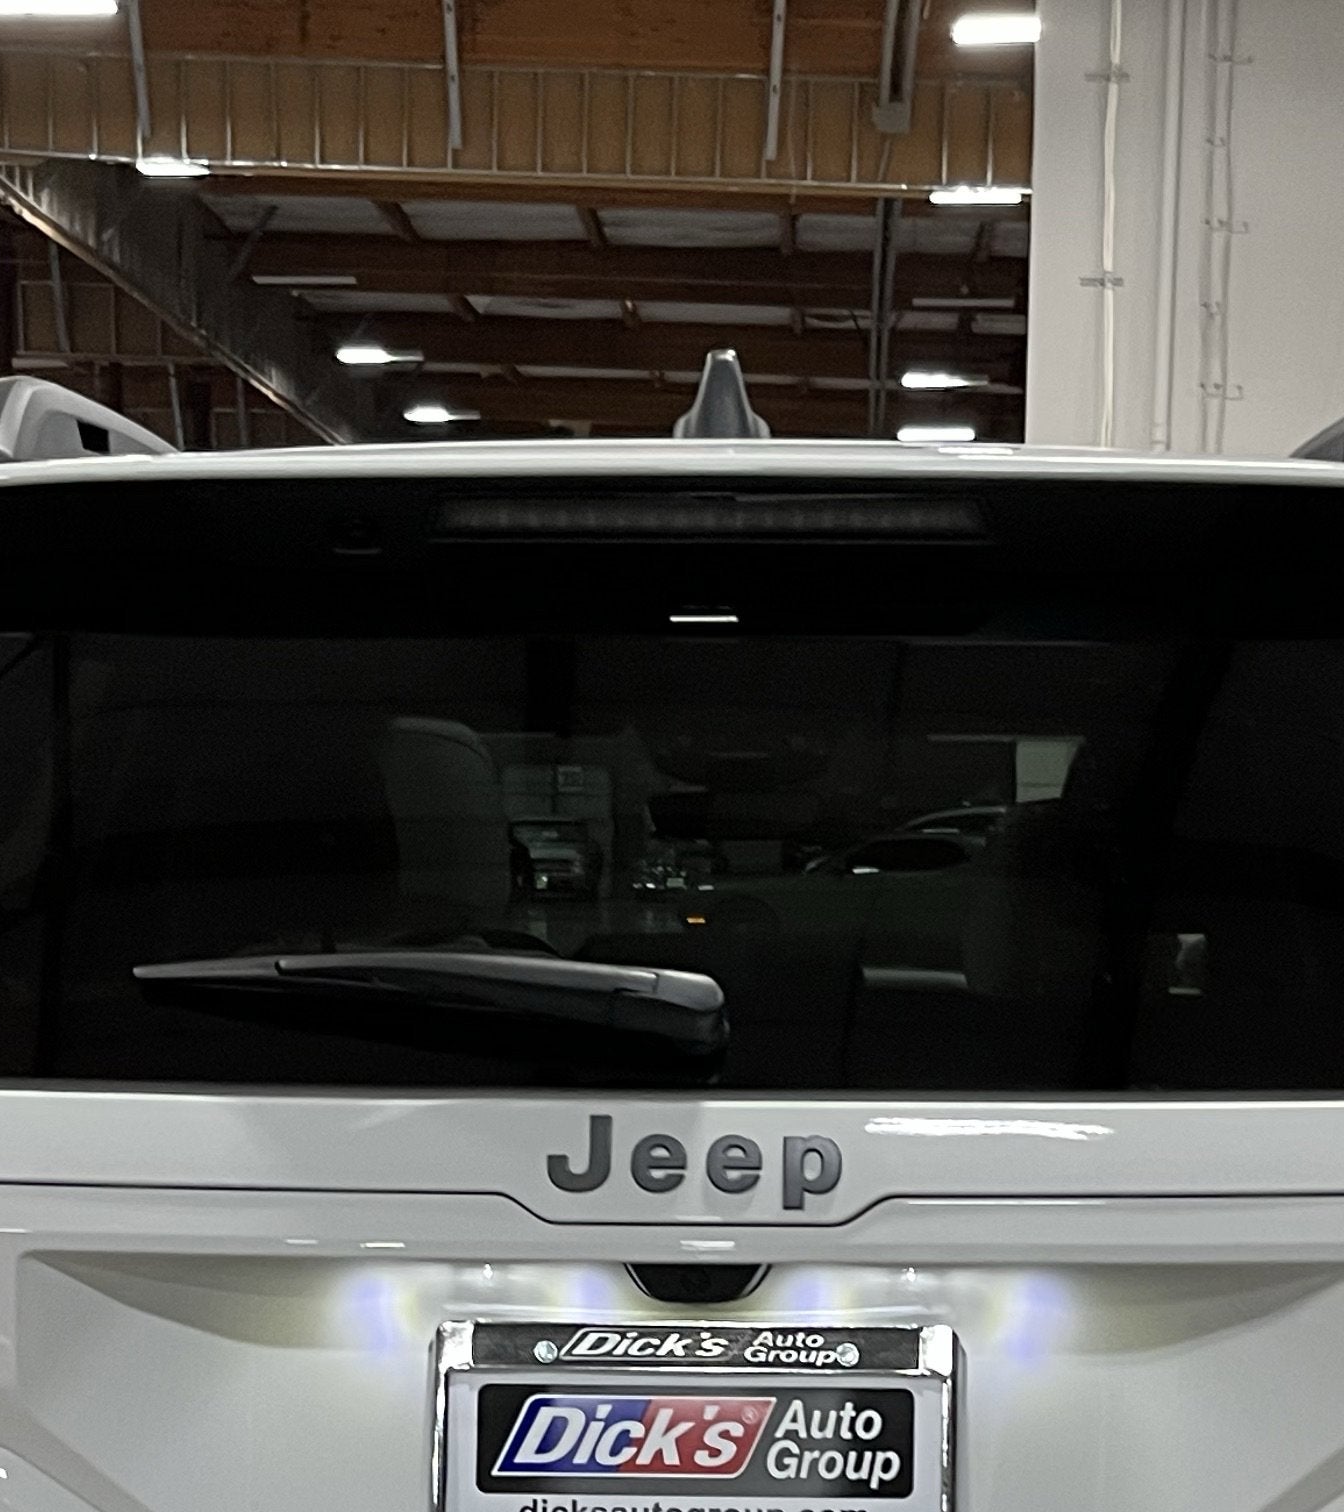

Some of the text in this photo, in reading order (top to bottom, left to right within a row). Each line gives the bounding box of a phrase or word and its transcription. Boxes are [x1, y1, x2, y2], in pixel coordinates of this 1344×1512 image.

[546, 1114, 842, 1211] Jeep
[572, 1332, 729, 1358] Dick's
[743, 1346, 839, 1367] Group
[752, 1331, 825, 1348] Auto
[513, 1404, 744, 1468] Dick's
[774, 1400, 882, 1440] Auto
[767, 1439, 901, 1490] Group
